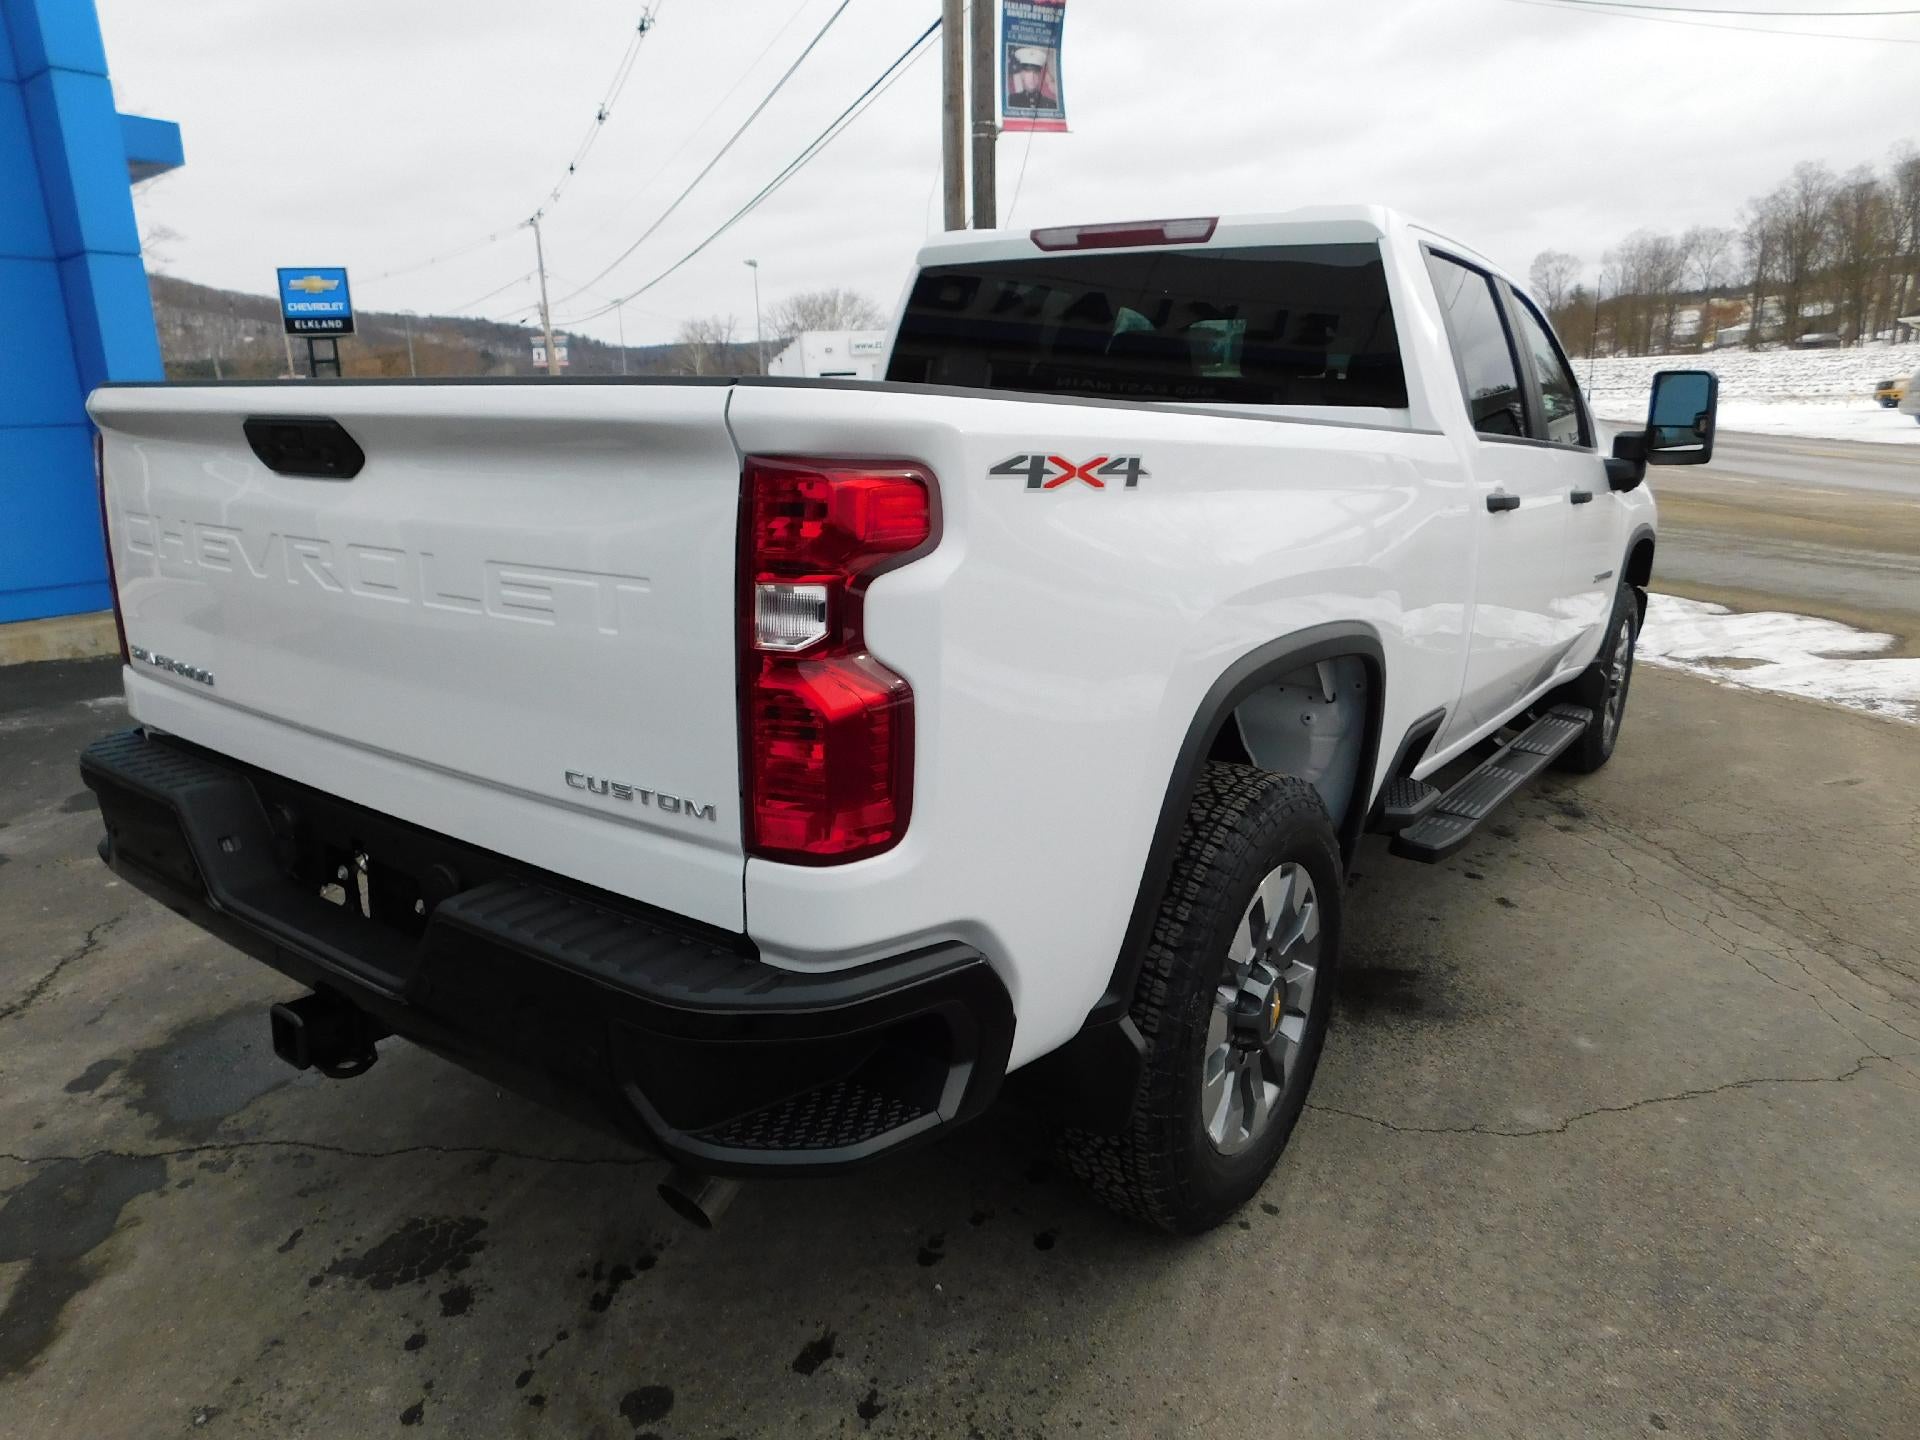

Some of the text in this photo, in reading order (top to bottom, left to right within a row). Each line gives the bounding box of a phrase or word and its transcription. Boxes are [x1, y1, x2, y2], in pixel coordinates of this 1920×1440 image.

[288, 302, 344, 311] CHEVROLET
[295, 320, 342, 329] ELKLAND
[125, 510, 650, 635] CHEVROLET
[564, 768, 718, 823] CUSTOM
